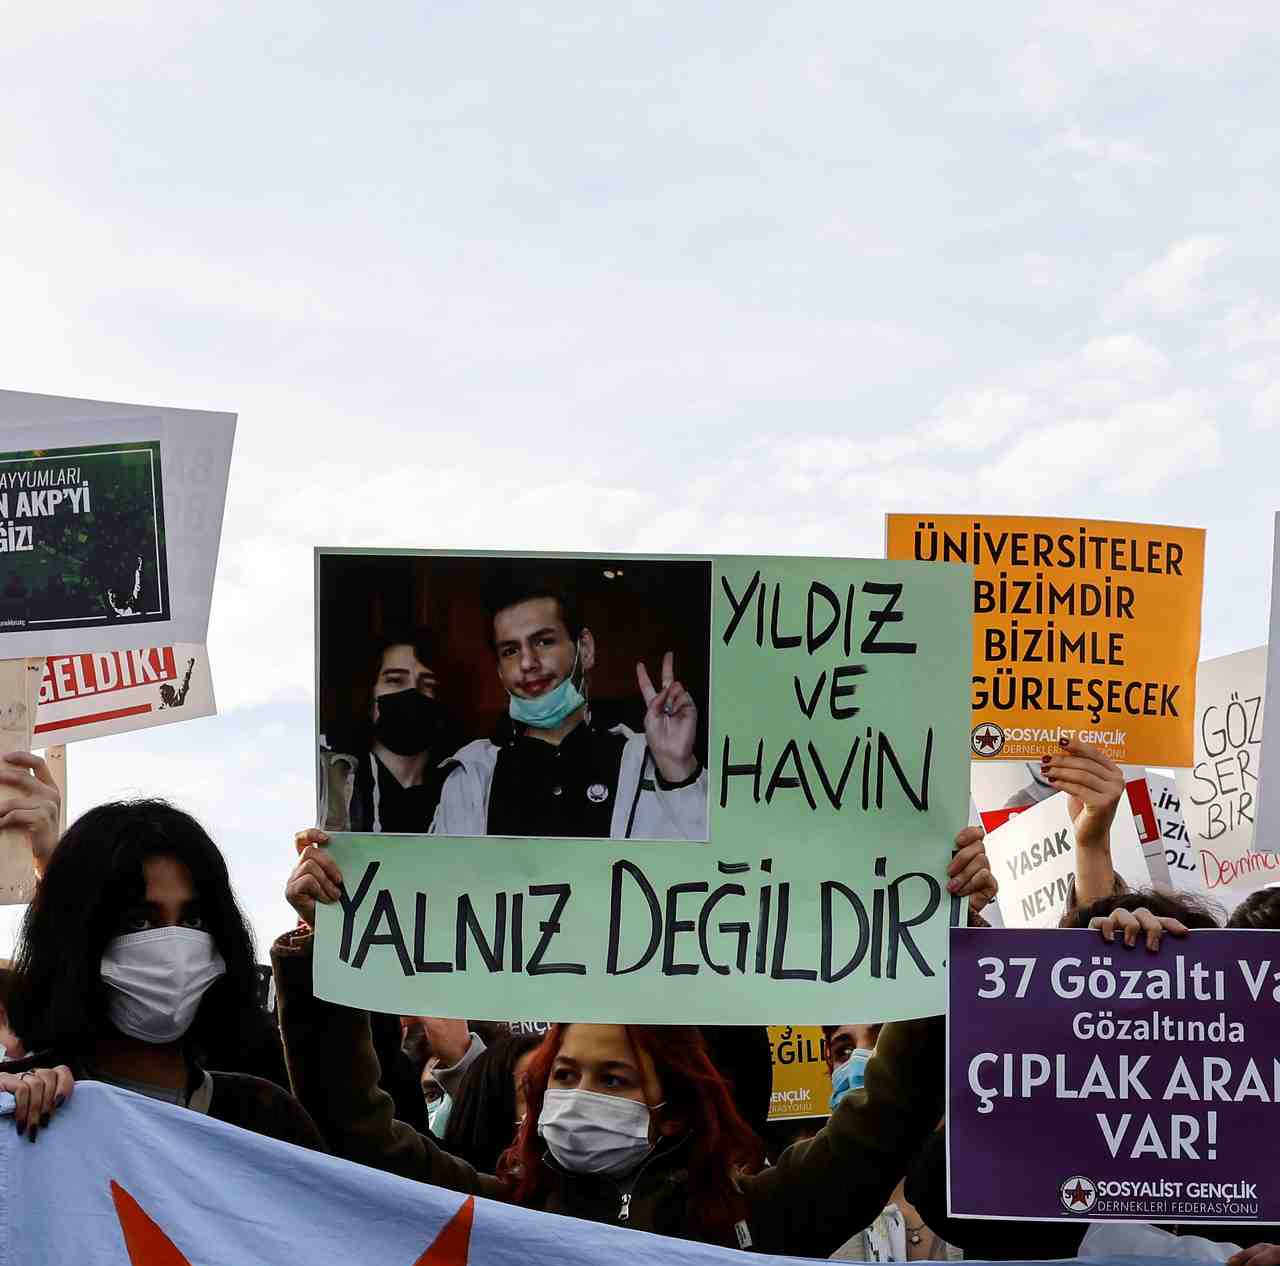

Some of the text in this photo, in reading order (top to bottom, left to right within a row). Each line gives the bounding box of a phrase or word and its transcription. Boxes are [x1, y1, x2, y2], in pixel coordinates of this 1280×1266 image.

[914, 522, 1183, 577] ÜNİVERSİTELER
[721, 571, 918, 654] YILDIZ
[974, 572, 1136, 619] BİZİMDİR
[985, 620, 1125, 666] BİZİMLE
[794, 665, 869, 720] VE
[1078, 728, 1127, 746] GENÇLİK
[720, 727, 933, 812] HAVİN
[338, 861, 587, 977] YALNIZ
[977, 957, 1037, 999] 37
[1051, 956, 1225, 1001] Gözaltı
[1072, 1011, 1246, 1043] Gözaltında
[967, 1053, 1152, 1113] ÇIPLAK
[1096, 1111, 1218, 1161] VAR!
[1097, 1200, 1258, 1214] DERNEKLERİ FEDERASYONU
[1098, 1178, 1258, 1202] SOSYALİST GENÇLİK
